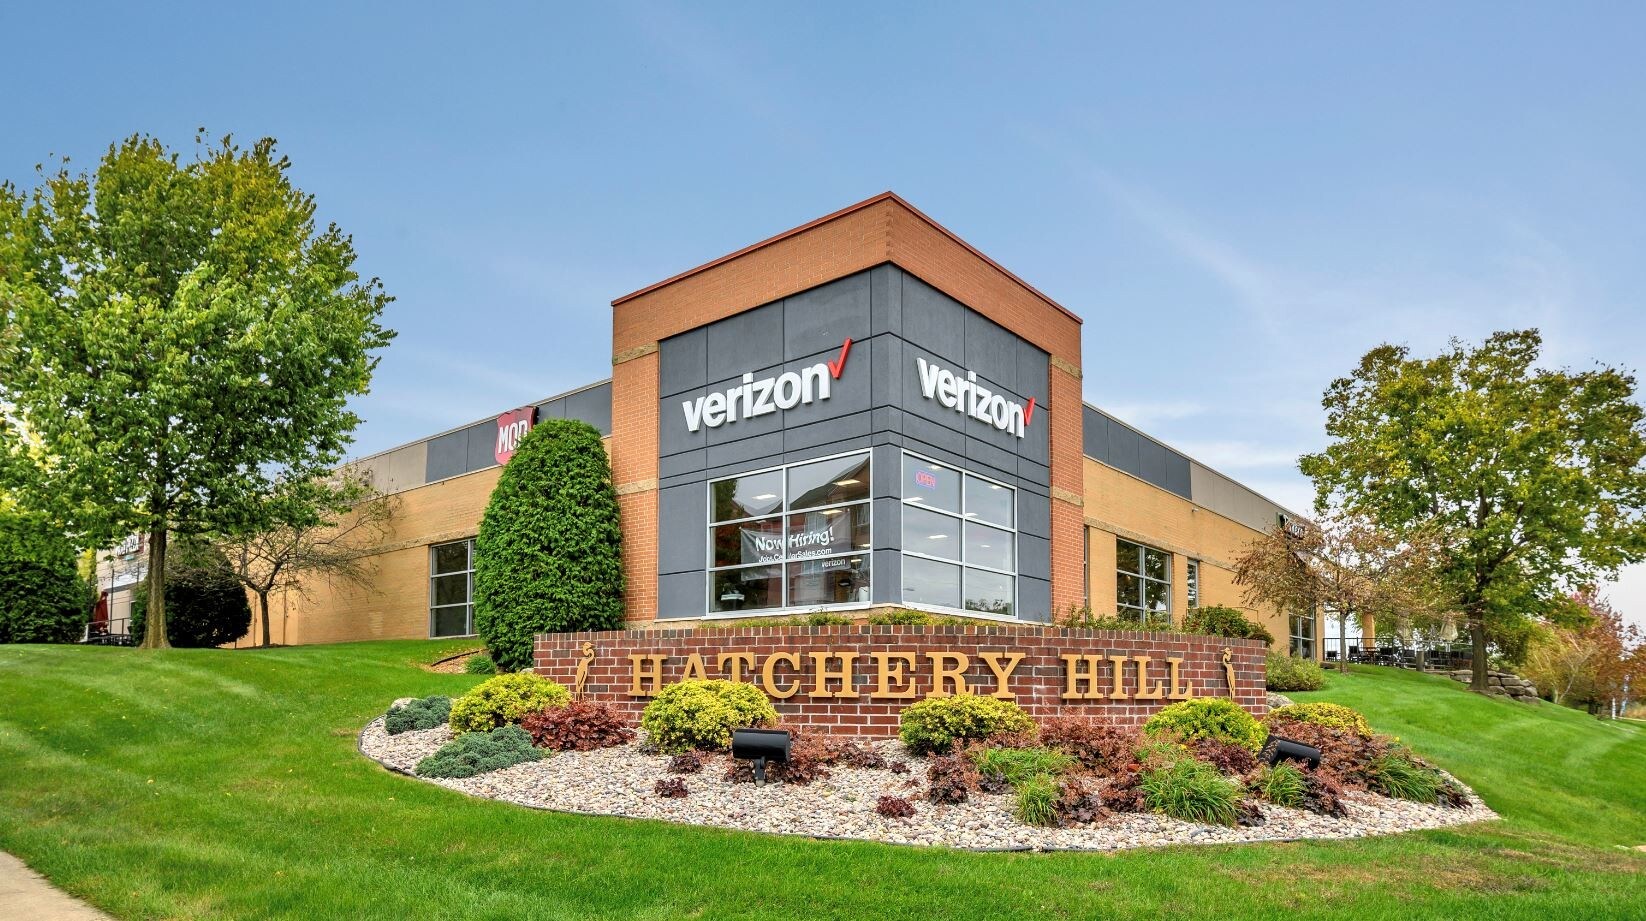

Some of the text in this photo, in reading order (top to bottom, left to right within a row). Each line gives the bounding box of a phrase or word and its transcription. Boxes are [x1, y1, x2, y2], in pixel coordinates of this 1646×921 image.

[682, 361, 831, 432] verizon
[916, 357, 1025, 439] verizon
[755, 526, 834, 551] Now Hiring!
[821, 557, 846, 568] verizon
[627, 650, 1193, 700] HATCHERY HILL
